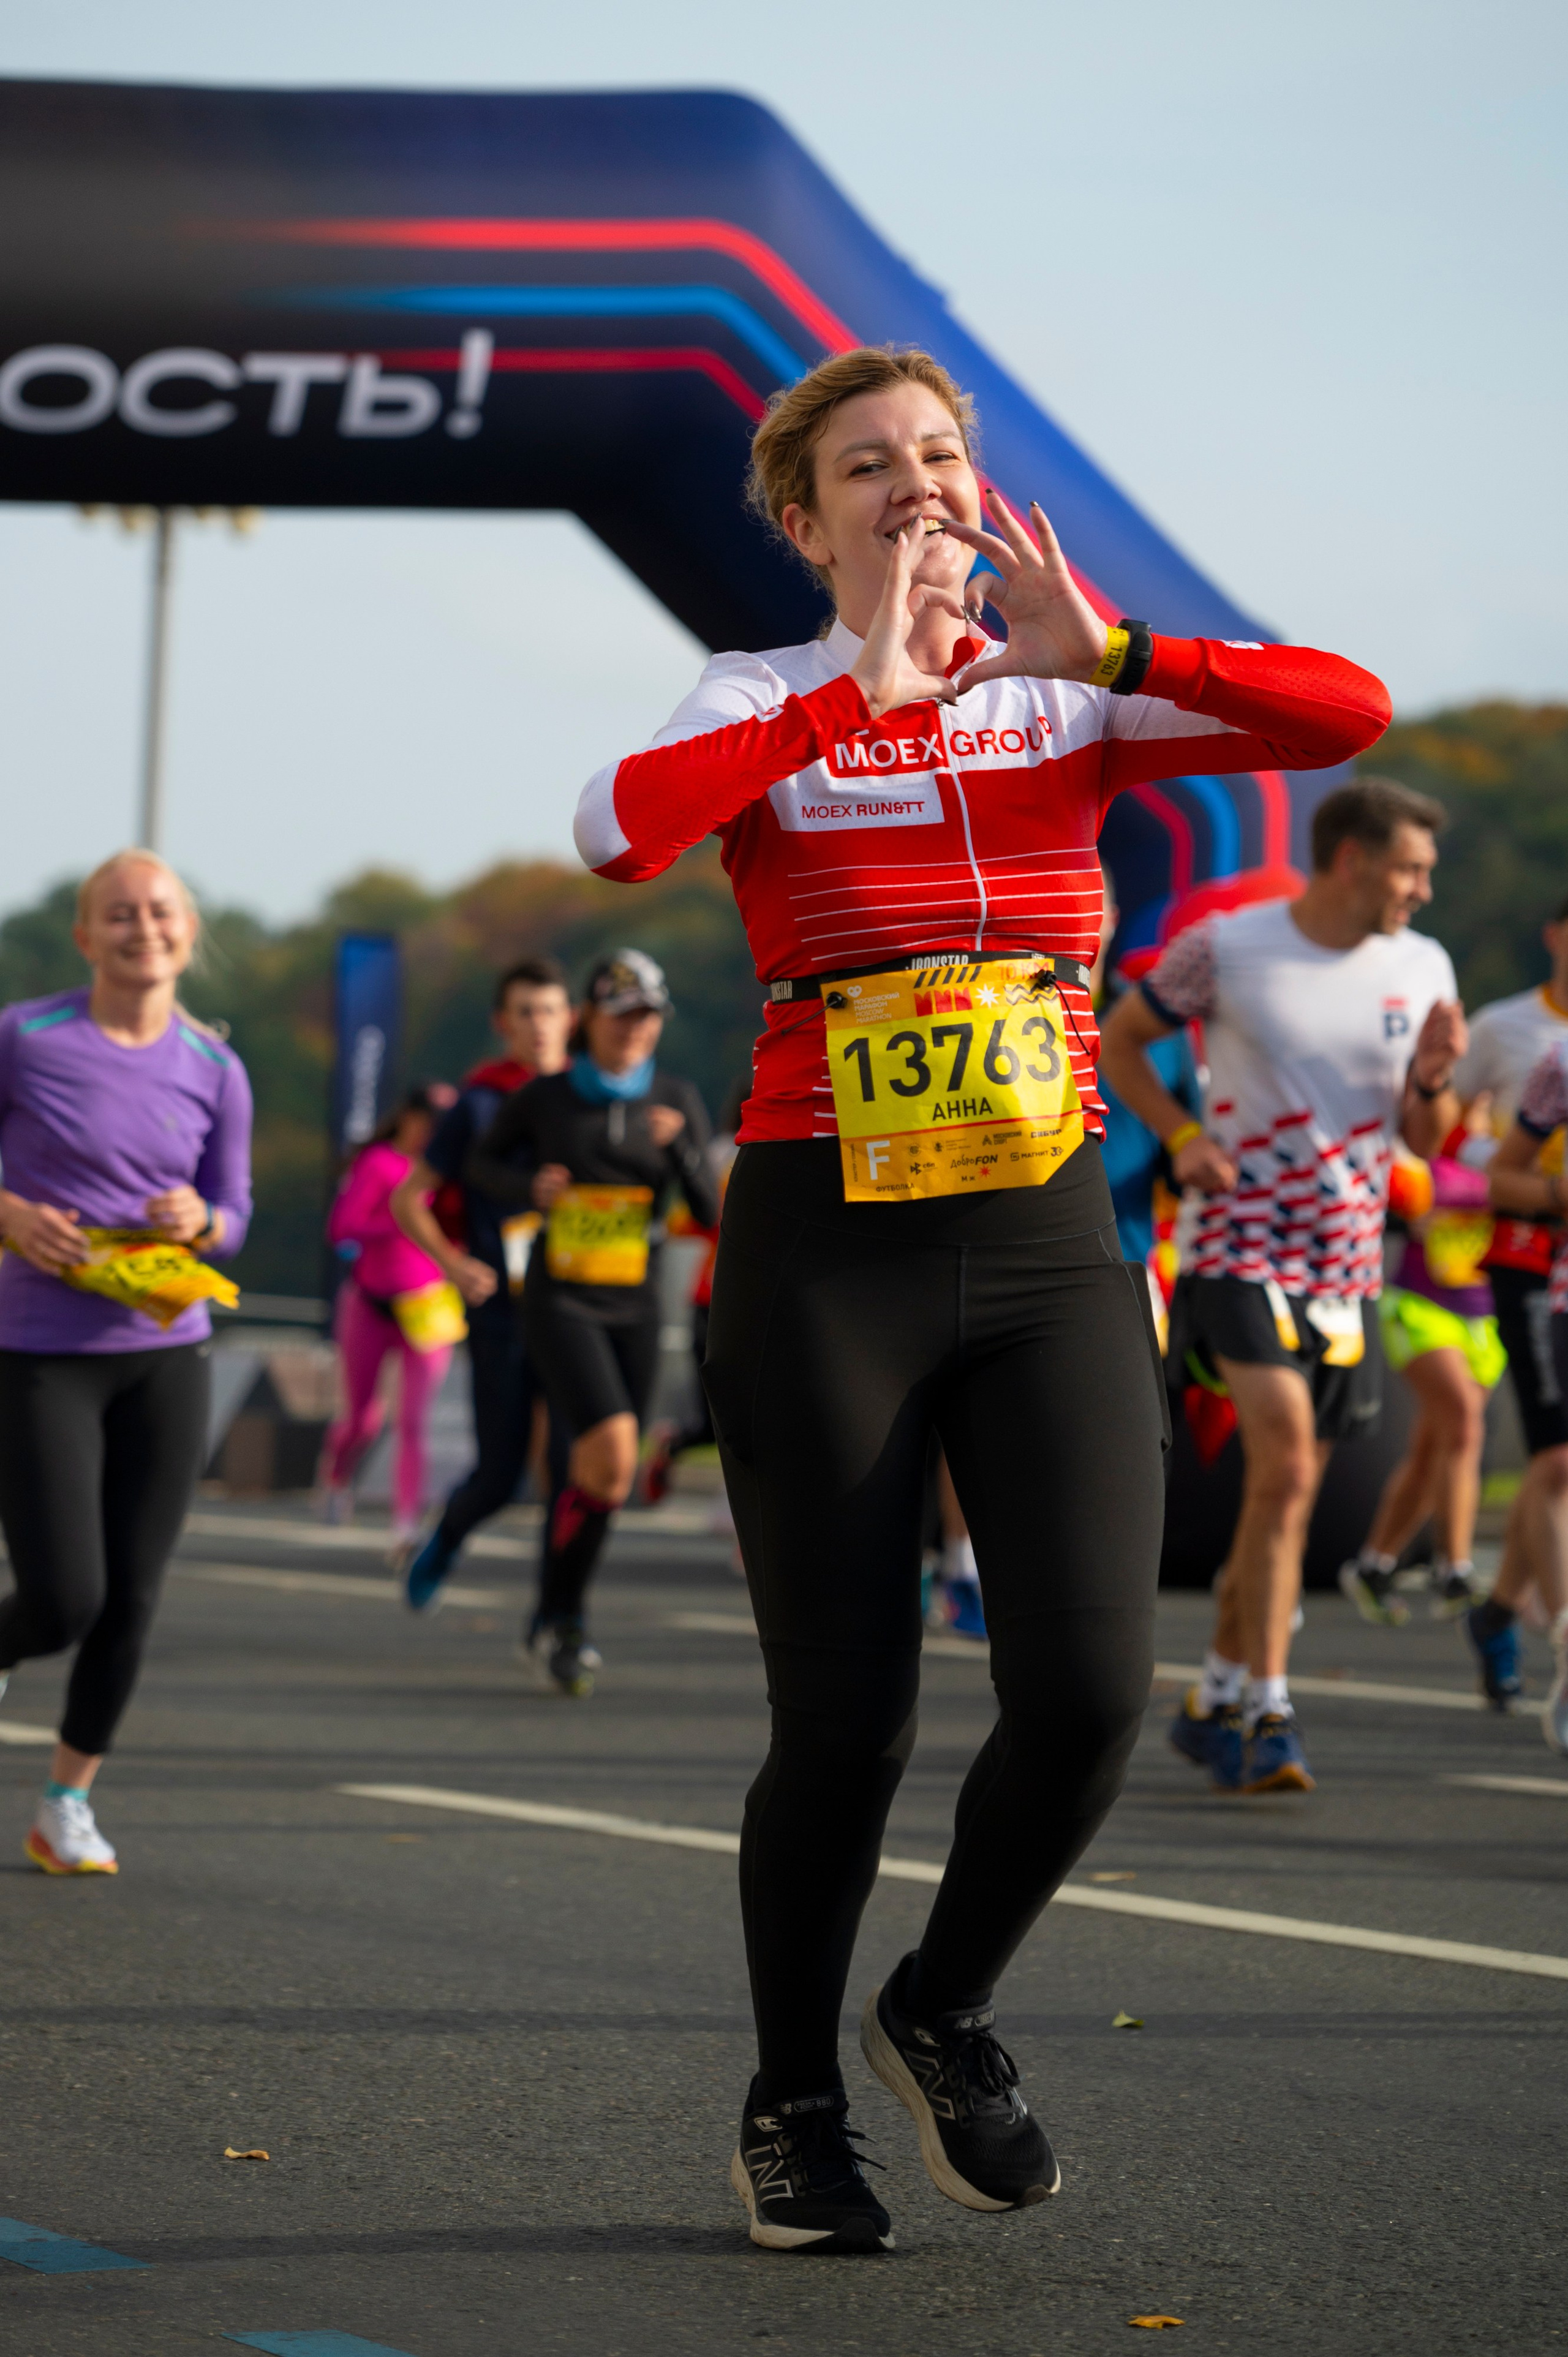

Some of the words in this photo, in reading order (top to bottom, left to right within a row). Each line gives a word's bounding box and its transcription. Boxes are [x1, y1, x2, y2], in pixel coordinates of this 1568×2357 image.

[1101, 647, 1123, 676] 13763
[834, 733, 944, 770] MOEX
[950, 715, 1053, 756] GROUP
[801, 804, 852, 819] MOEX
[856, 801, 925, 816] RUN&TT
[998, 964, 1017, 980] 10
[854, 992, 900, 1005] МОСКОВСКИЙ
[854, 1001, 888, 1011] МАРАФОН
[856, 1008, 884, 1017] MOSCOW
[857, 1013, 892, 1024] MARATHON
[843, 1016, 1061, 1103] 13763
[932, 1096, 993, 1122] АННА
[866, 1140, 891, 1180] F
[1021, 1150, 1049, 1159] МАГНИТ
[876, 1183, 915, 1193] ФУТБОЛКА
[816, 2098, 831, 2107] 880
